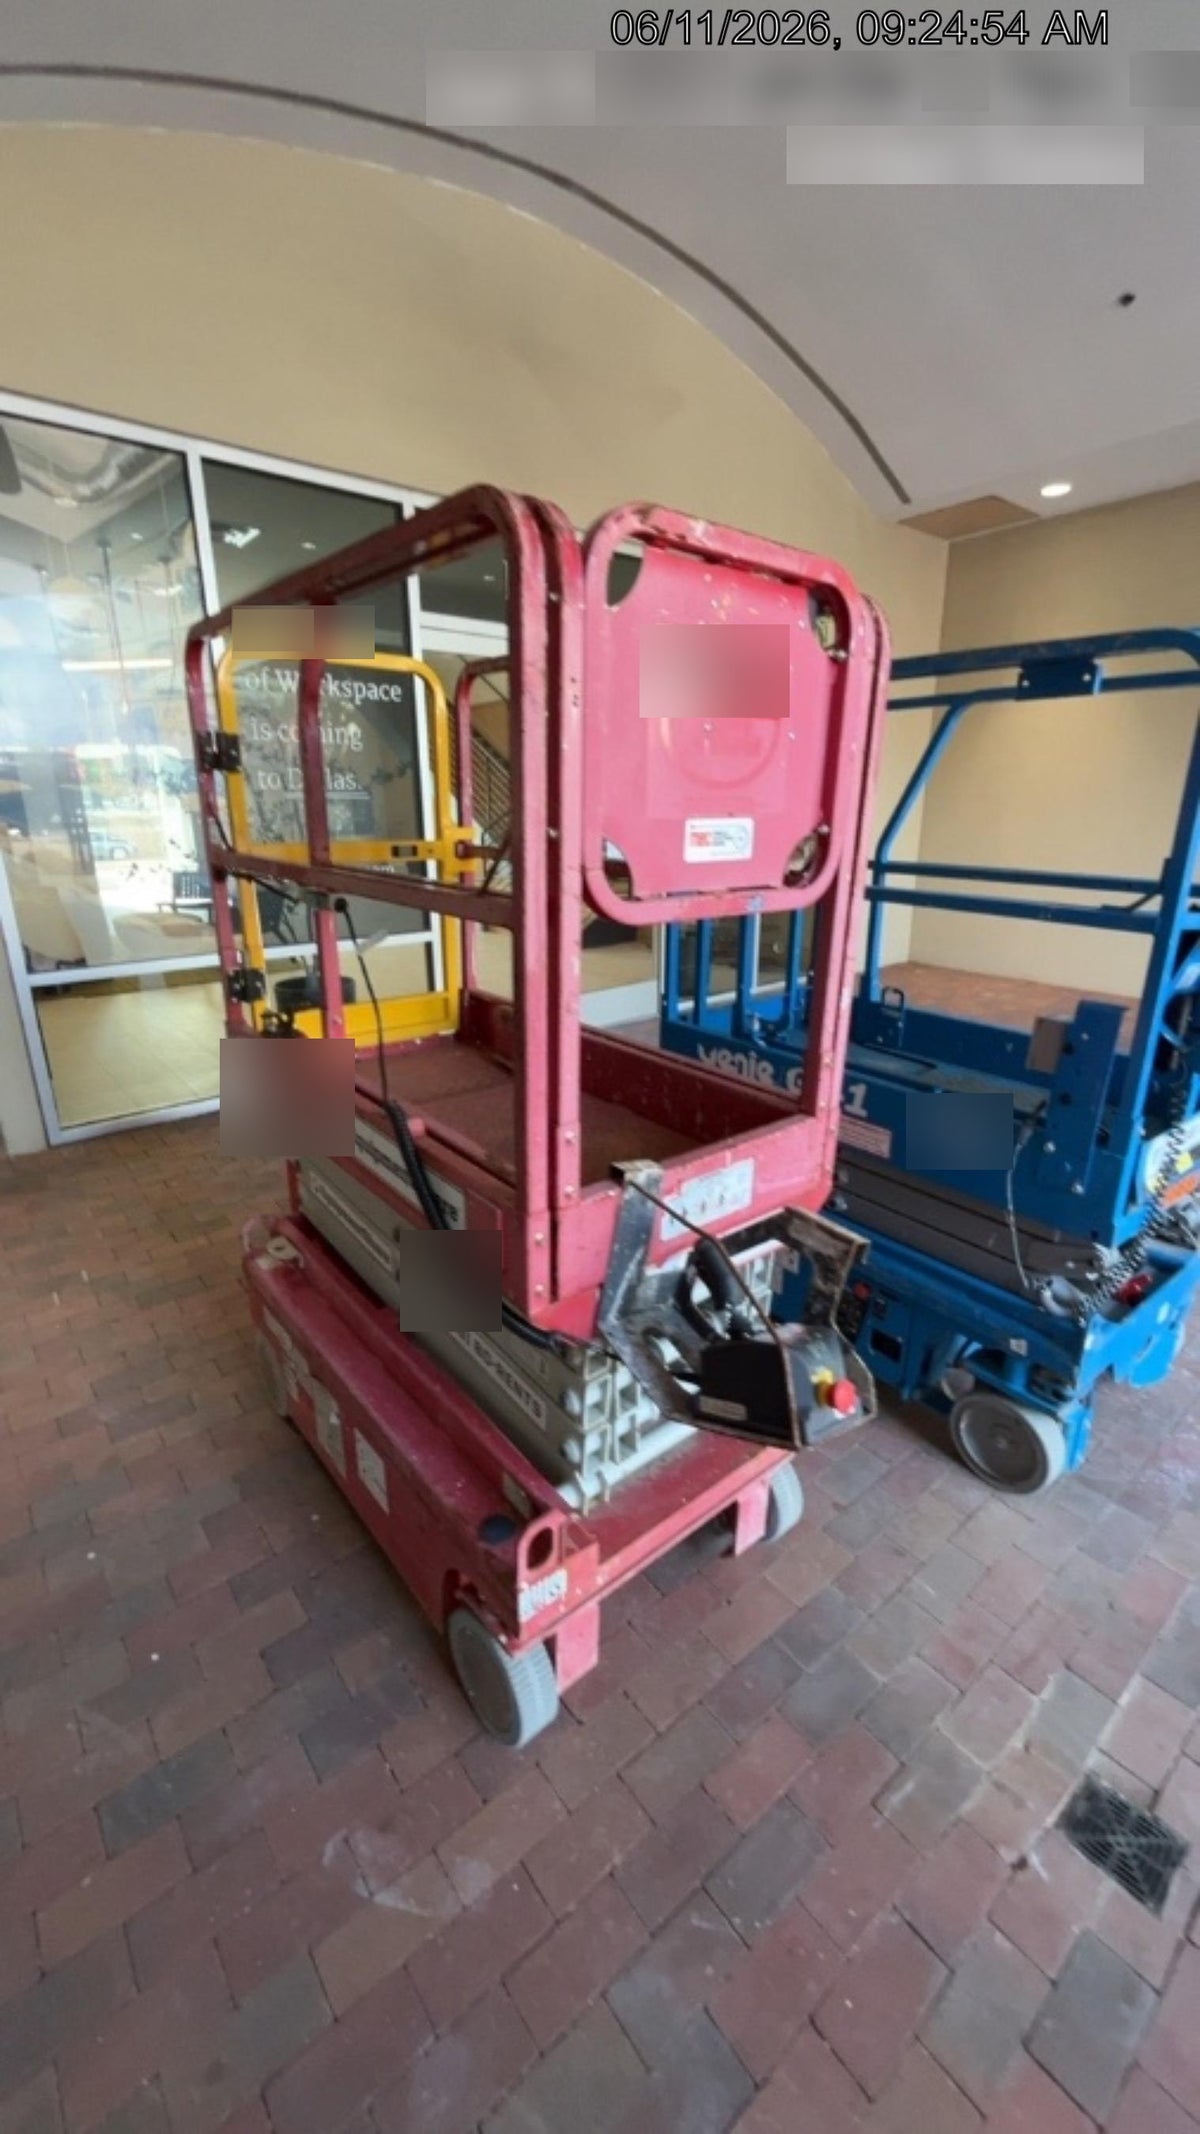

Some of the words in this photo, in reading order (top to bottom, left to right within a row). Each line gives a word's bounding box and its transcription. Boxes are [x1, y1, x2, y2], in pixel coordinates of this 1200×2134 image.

[244, 666, 270, 691] of
[275, 668, 403, 705] Wkspace
[250, 716, 272, 741] is
[258, 769, 281, 791] to
[288, 767, 363, 791] Dlas.
